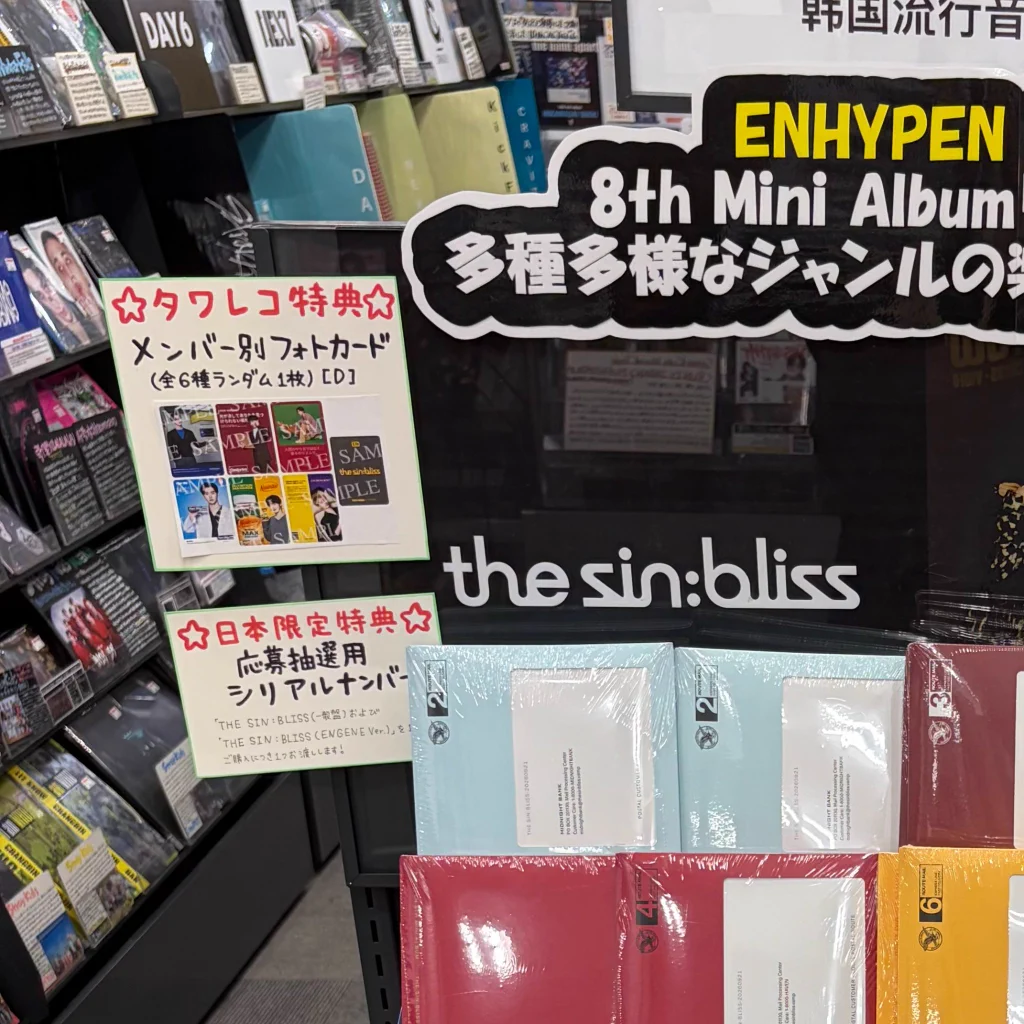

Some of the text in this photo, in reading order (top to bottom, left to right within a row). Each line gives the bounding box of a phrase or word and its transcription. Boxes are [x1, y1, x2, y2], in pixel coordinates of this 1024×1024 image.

[140, 10, 194, 49] DAY6
[734, 101, 1006, 163] ENHYPEN
[590, 166, 692, 229] 8th
[714, 170, 826, 228] Mini
[131, 332, 390, 366] メンバー別フォトカード
[442, 534, 570, 607] the
[236, 640, 367, 678] 応募抽選用
[427, 692, 448, 709] 2
[696, 697, 717, 714] 2
[930, 693, 951, 708] 3
[636, 901, 659, 918] 4
[919, 897, 941, 914] 6
